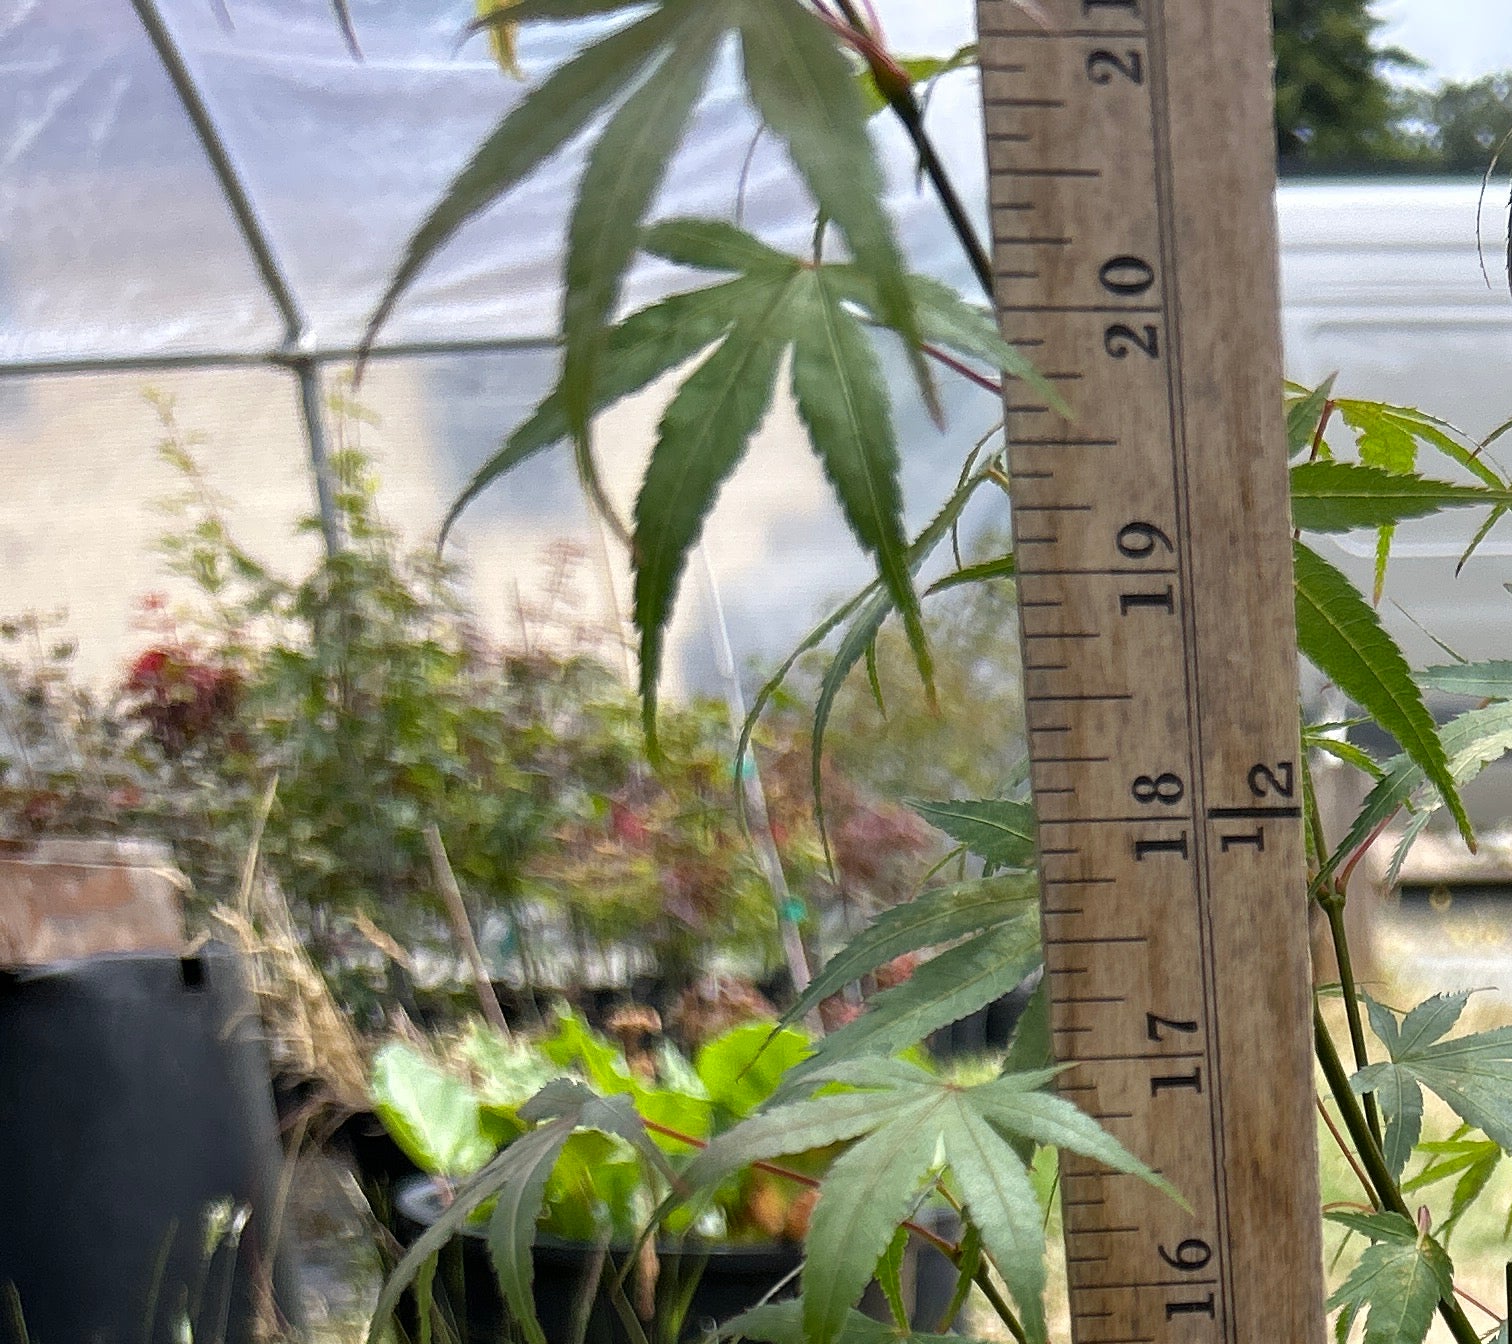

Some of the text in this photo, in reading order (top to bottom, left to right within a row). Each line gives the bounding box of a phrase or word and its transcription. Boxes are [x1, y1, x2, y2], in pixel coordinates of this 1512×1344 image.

[1099, 255, 1159, 360] 20
[1116, 521, 1174, 617] 19
[1131, 772, 1189, 862] 18
[1147, 1010, 1202, 1098] 17
[1158, 1237, 1215, 1322] 16
